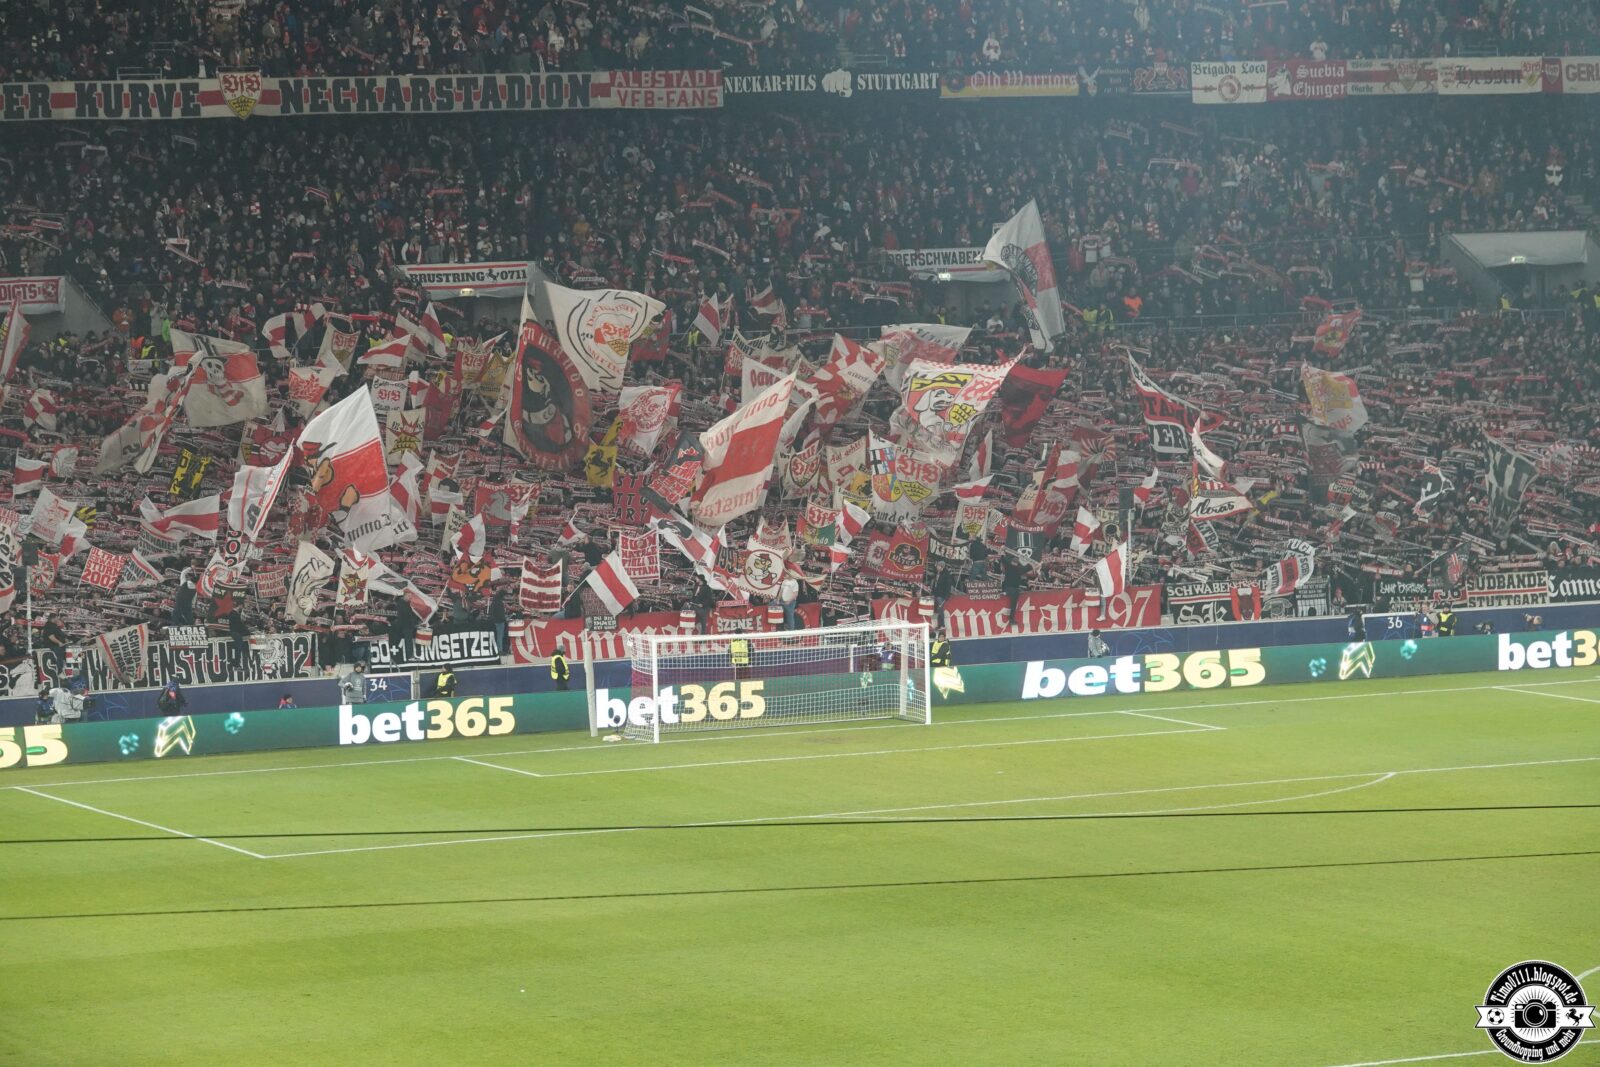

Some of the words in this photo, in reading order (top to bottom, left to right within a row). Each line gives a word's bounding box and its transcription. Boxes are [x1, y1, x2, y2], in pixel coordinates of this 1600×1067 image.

[613, 70, 722, 87] ALBSTADT
[1192, 64, 1236, 77] Brigada
[1241, 63, 1267, 75] Loca
[1296, 64, 1345, 79] Suebia
[222, 73, 261, 94] VfB
[723, 74, 817, 94] NECKAR-FILS
[857, 72, 939, 91] STUTTGART
[970, 69, 1001, 91] Old
[1004, 70, 1079, 91] Warriors
[75, 82, 200, 119] KURVE
[278, 73, 592, 115] NECKARSTADION
[616, 89, 719, 108] VFB-FANS
[408, 271, 485, 284] BRUSTRING
[500, 269, 527, 280] 0711
[896, 454, 940, 484] VfB
[91, 547, 127, 563] ULTRAS
[86, 560, 121, 577] STURM
[81, 568, 117, 590] 2002
[1468, 592, 1548, 608] STUTTGART
[168, 626, 206, 636] ULTRAS
[716, 617, 754, 632] SZENE
[1387, 616, 1403, 629] 36
[169, 639, 209, 647] WIDERSTAND
[370, 637, 408, 663] 50+1
[413, 630, 499, 662] UMSETZEN
[1497, 629, 1600, 672] bet3
[1021, 647, 1266, 700] bet365
[369, 677, 388, 692] 34
[595, 680, 766, 728] bet365
[338, 696, 516, 746] bet365
